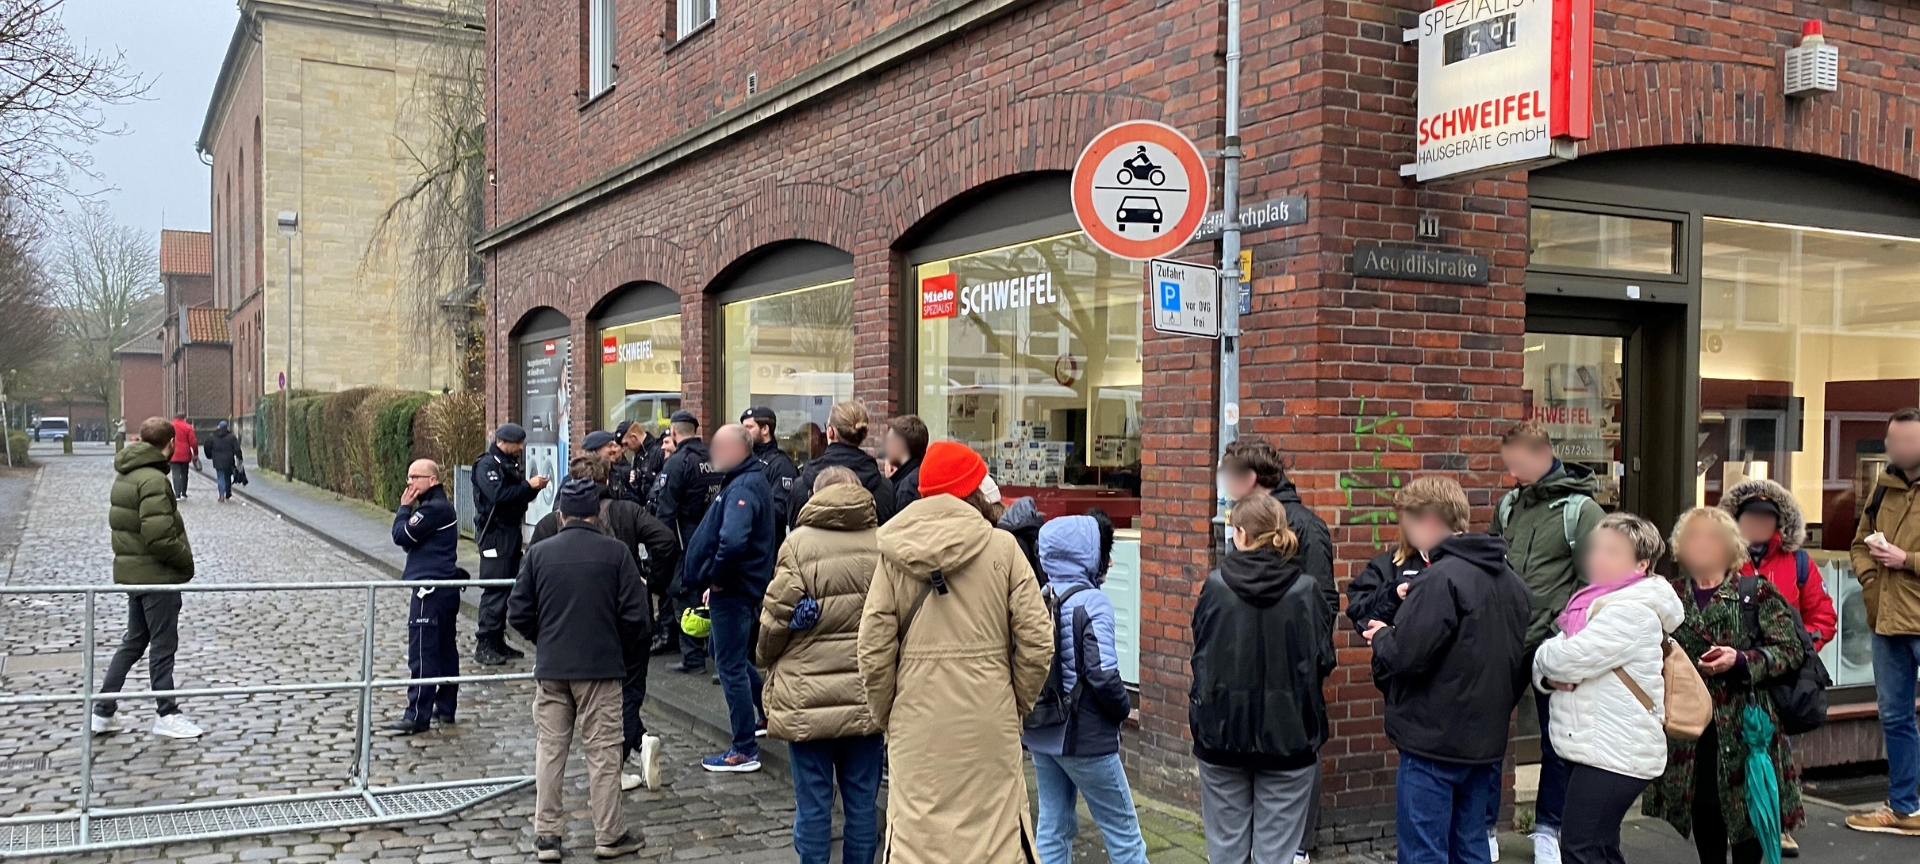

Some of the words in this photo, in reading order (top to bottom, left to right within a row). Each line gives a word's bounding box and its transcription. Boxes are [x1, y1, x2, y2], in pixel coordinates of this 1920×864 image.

[1419, 90, 1546, 146] SCHWEIFEL
[1419, 134, 1491, 167] HAUSGERÄTE
[1496, 124, 1546, 147] GmbH
[1423, 219, 1437, 236] 11
[1156, 264, 1185, 280] Zufahrt
[1364, 249, 1477, 278] Aegidiistraße
[923, 289, 954, 303] Miele
[961, 272, 1056, 316] SCHWEIFEL
[1165, 285, 1176, 307] P
[923, 302, 953, 316] SPEZIALIST
[1185, 301, 1196, 311] vor
[1193, 315, 1205, 328] frei
[618, 340, 654, 362] SCHWEIFEL
[1523, 405, 1593, 425] HWEIFEL
